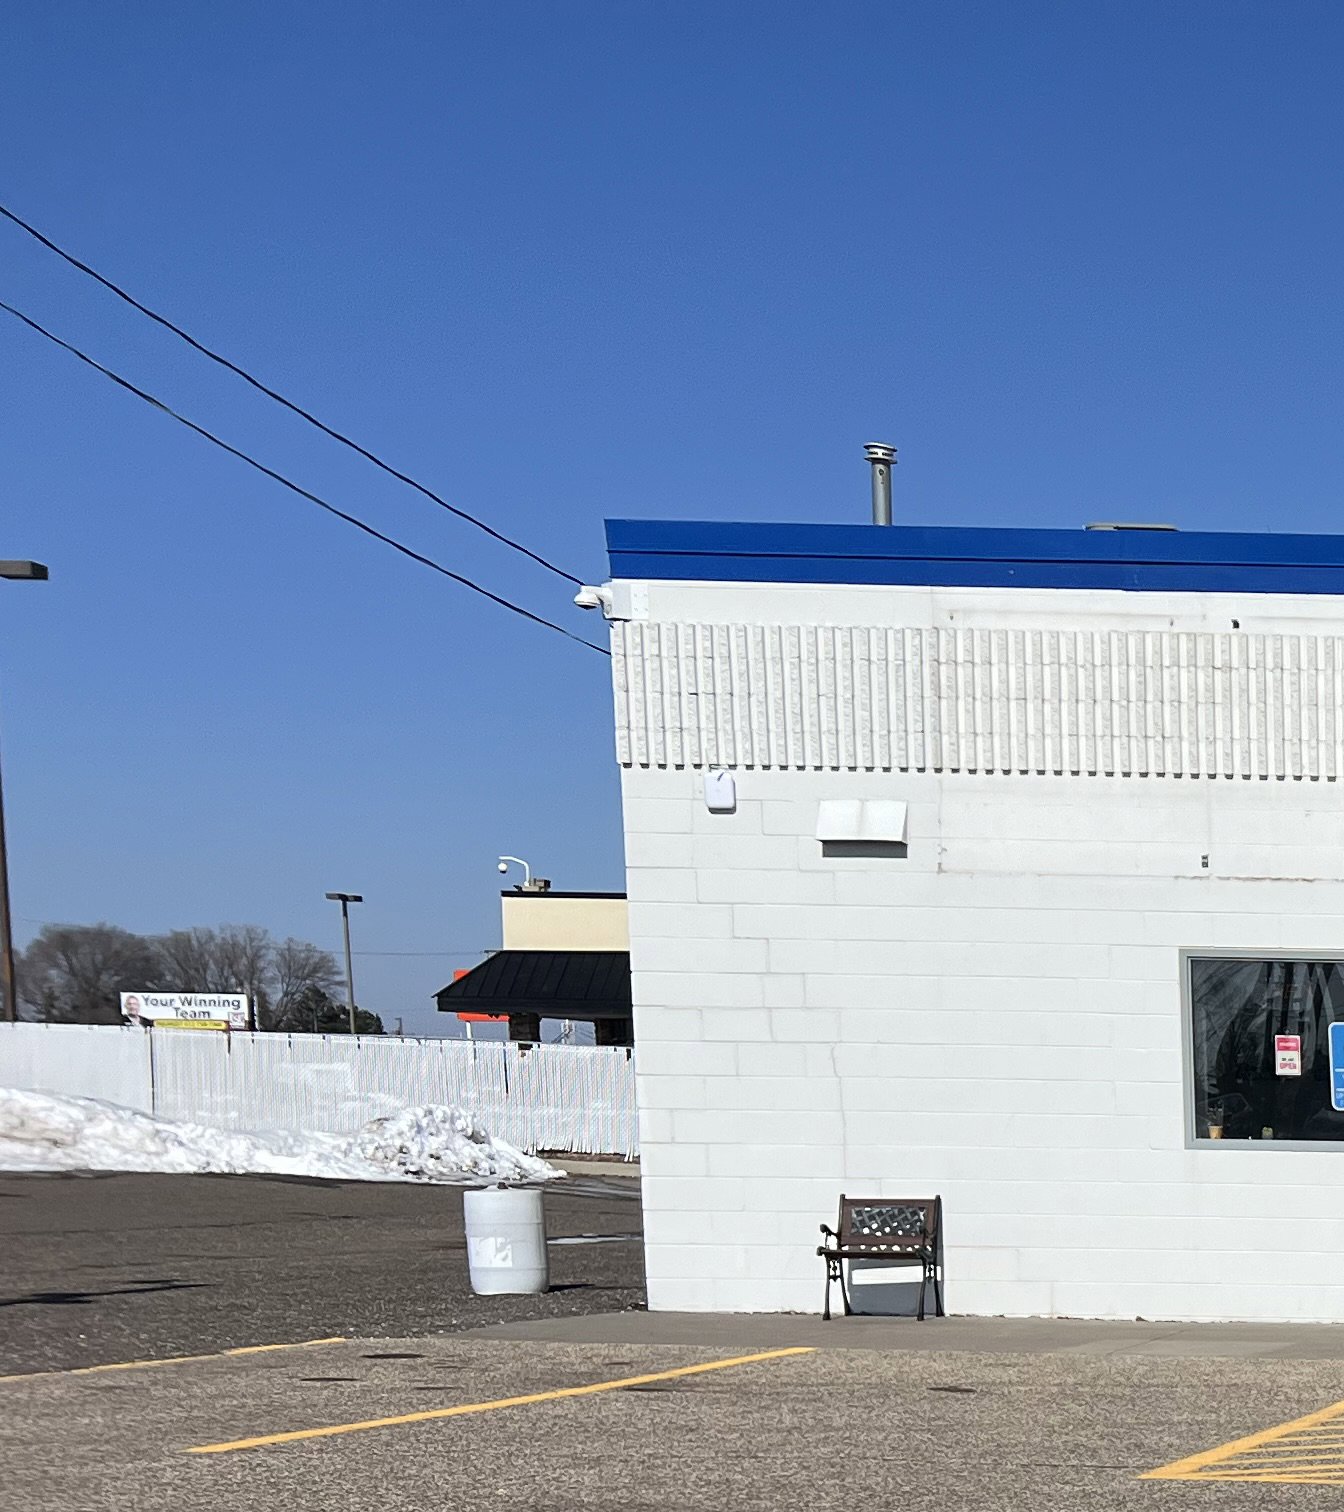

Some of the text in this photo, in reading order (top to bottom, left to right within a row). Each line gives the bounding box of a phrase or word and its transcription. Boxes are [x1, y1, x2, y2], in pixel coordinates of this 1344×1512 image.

[142, 995, 241, 1009] Your Winning
[173, 1007, 211, 1019] Team
